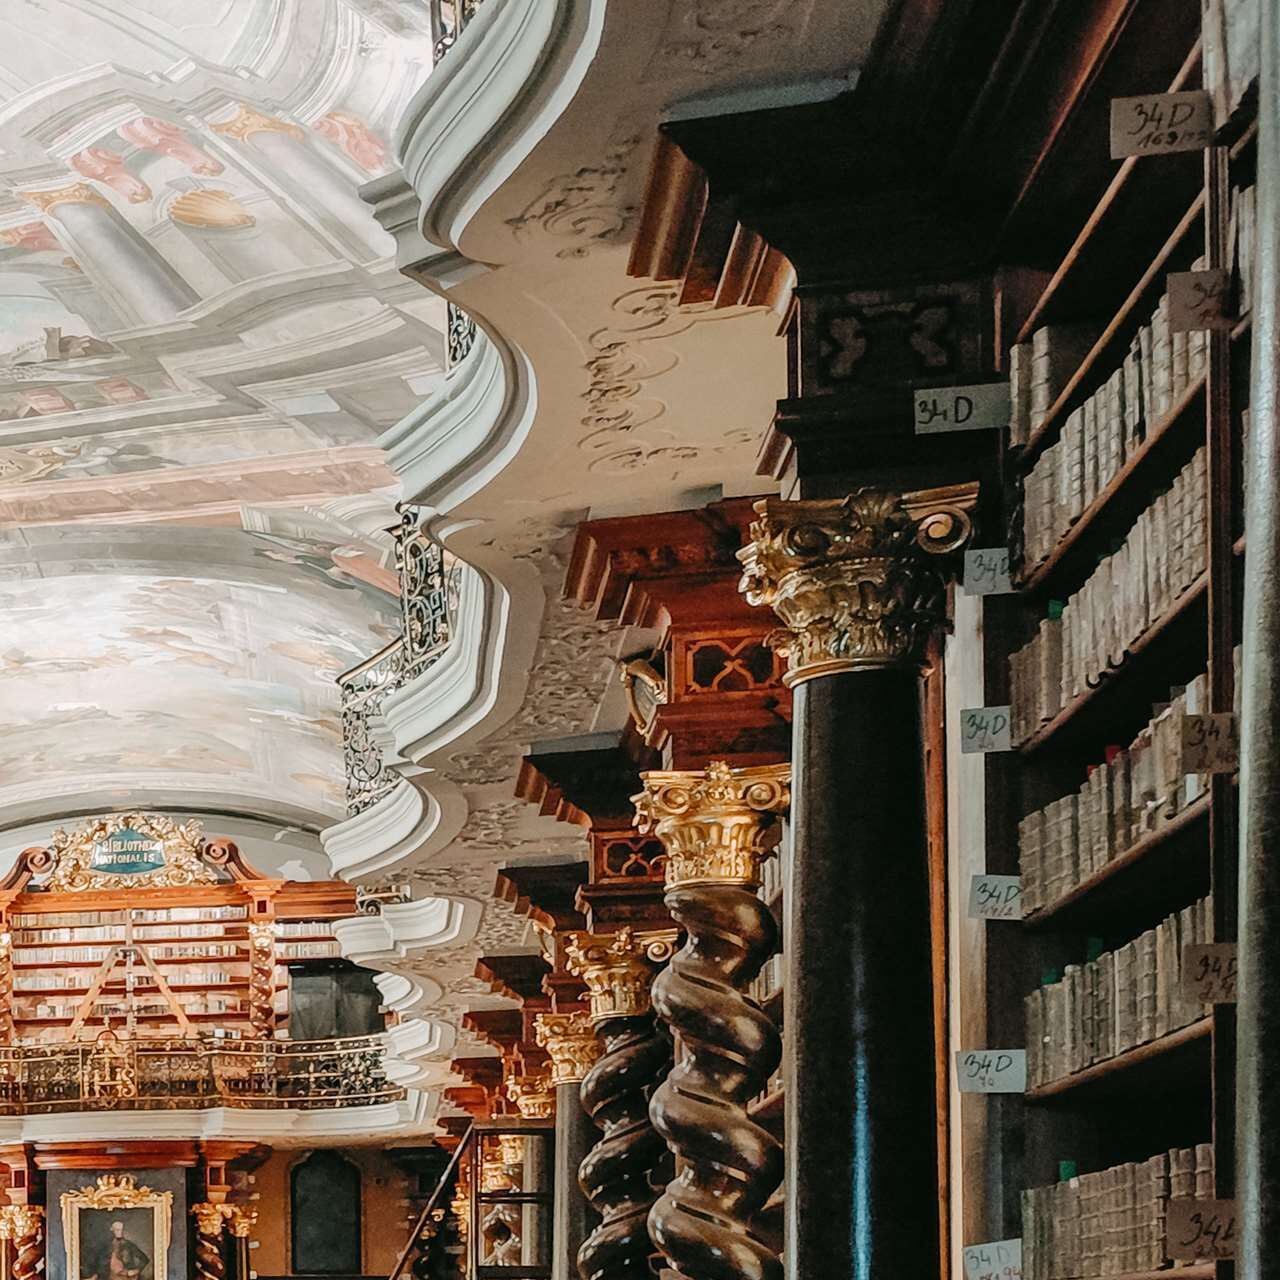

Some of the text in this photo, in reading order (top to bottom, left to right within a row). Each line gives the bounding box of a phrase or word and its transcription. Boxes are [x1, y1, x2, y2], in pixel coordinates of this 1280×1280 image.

[1127, 102, 1195, 135] 34D
[918, 396, 973, 424] 34D
[967, 714, 1007, 740] 34D
[95, 852, 156, 865] NATIONALIS
[976, 882, 1023, 905] 34D
[964, 1054, 1013, 1078] 34D
